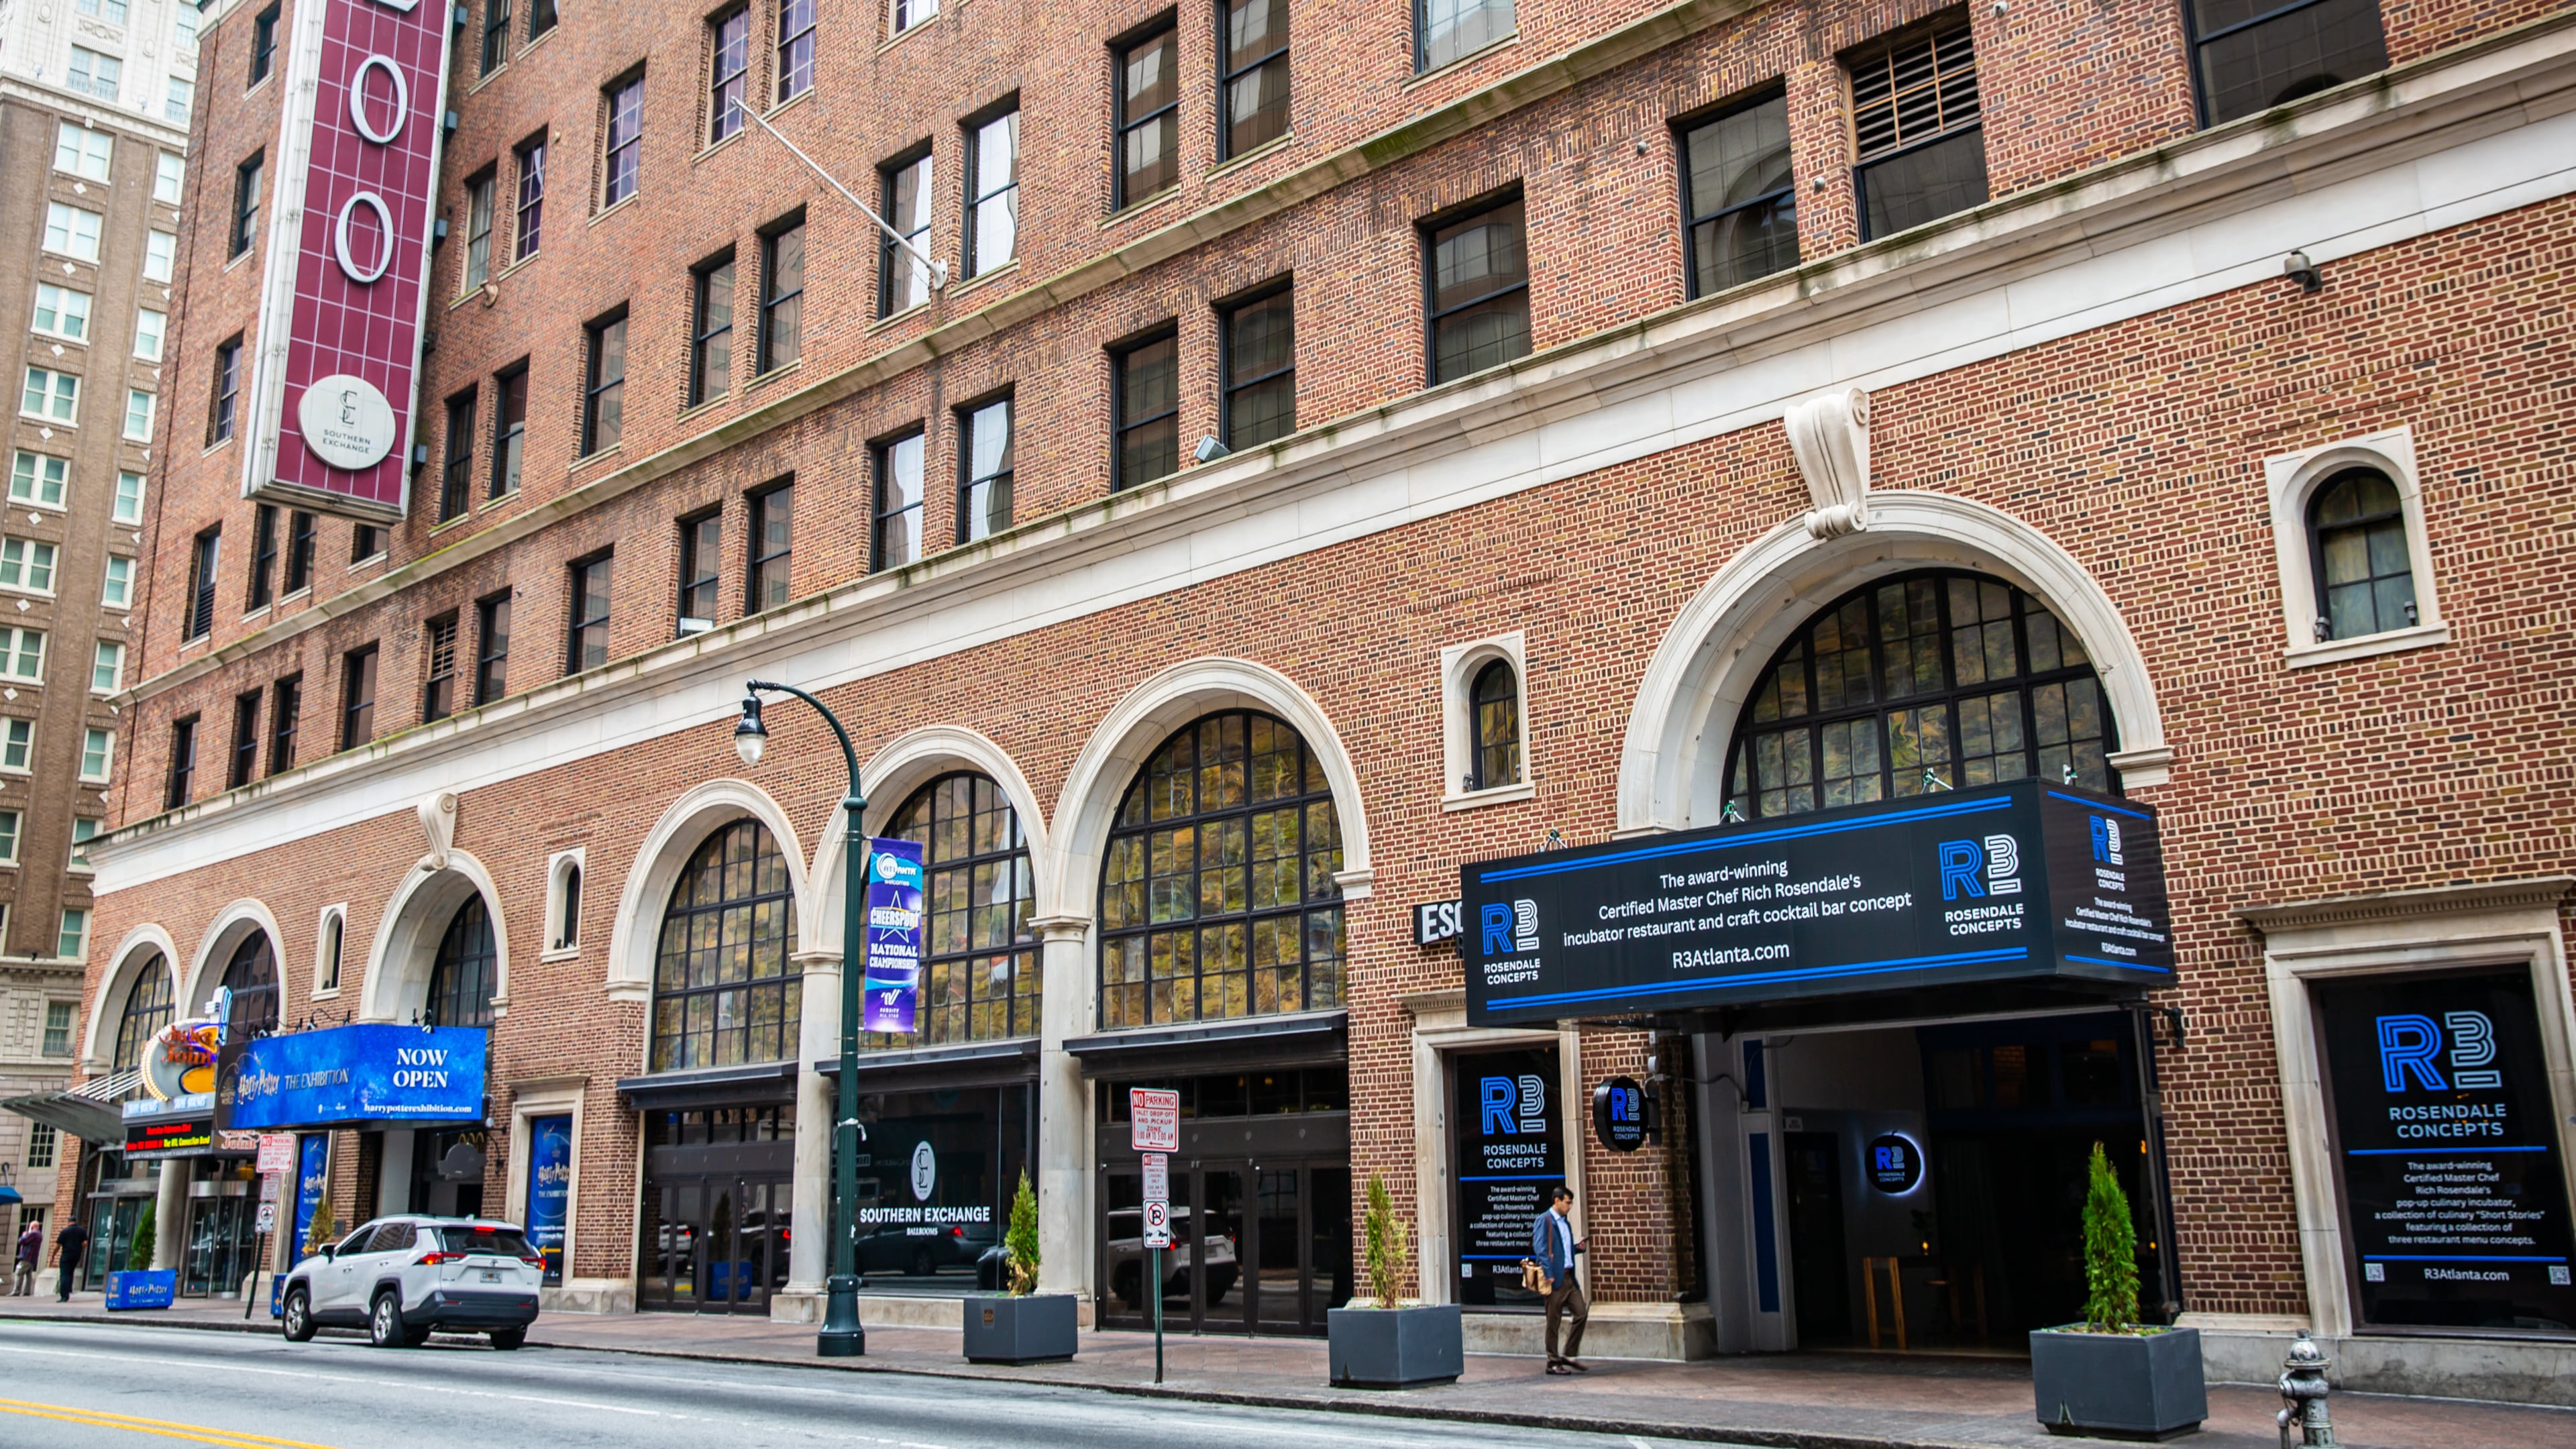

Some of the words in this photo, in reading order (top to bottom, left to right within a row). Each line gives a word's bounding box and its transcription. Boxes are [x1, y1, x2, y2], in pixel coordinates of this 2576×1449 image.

[335, 0, 420, 282] 00
[323, 429, 370, 445] SOUTHERN
[323, 438, 370, 454] EXCHANGE
[2089, 814, 2124, 865] R3
[1660, 873, 1685, 890] The
[1687, 860, 1788, 888] award-winning
[1938, 834, 2022, 900] R3
[2096, 867, 2125, 882] ROSENDALE
[2098, 878, 2125, 892] CONCEPTS
[1598, 899, 1654, 920] Certified
[1658, 894, 1703, 913] Master
[1706, 889, 1739, 907] Chef
[1742, 885, 1772, 902] Rich
[1775, 874, 1862, 898] Rosendale's
[870, 908, 920, 928] CHEERSPORT
[1563, 928, 1625, 947] incubator
[1627, 918, 1696, 938] restaurant
[1698, 913, 1724, 930] and
[1726, 908, 1761, 926] craft
[1763, 901, 1819, 924] cocktail
[1821, 898, 1846, 916] bar
[1849, 892, 1912, 914] concept
[1945, 903, 2024, 924] ROSENDALE
[1481, 898, 1540, 955] R3
[1949, 918, 2021, 936] CONCEPTS
[871, 943, 918, 957] NATIONAL
[1672, 943, 1790, 969] R3Atlanta.com
[869, 957, 918, 970] CHAMPIONSHIP
[1484, 958, 1540, 973] ROSENDALE
[1487, 970, 1539, 985] CONCEPTS
[161, 1046, 211, 1065] Joint
[396, 1048, 448, 1066] NOW
[2376, 1010, 2502, 1092] R3
[238, 1075, 258, 1105] Harry
[258, 1069, 280, 1096] Potter
[285, 1075, 300, 1090] THE
[301, 1068, 350, 1089] EXHIBITION
[393, 1070, 448, 1088] OPEN
[1133, 1093, 1144, 1107] NO
[1146, 1095, 1174, 1106] PARKING
[1481, 1075, 1546, 1135] R3
[1611, 1088, 1640, 1121] R3
[364, 1103, 472, 1114] harrypotterexhibition.com
[2389, 1104, 2507, 1120] ROSENDALE
[2397, 1122, 2504, 1138] CONCEPTS
[221, 1137, 256, 1149] Joint
[263, 1136, 272, 1146] NO
[1483, 1144, 1547, 1156] ROSENDALE
[1487, 1157, 1544, 1169] CONCEPTS
[2408, 1161, 2424, 1171] The
[2426, 1161, 2492, 1171] award-winning
[2404, 1173, 2443, 1182] Certified
[2445, 1173, 2475, 1182] Master
[2477, 1173, 2500, 1181] Chef
[2416, 1185, 2435, 1195] Rich
[2436, 1185, 2491, 1195] Rosendale's
[2396, 1199, 2428, 1208] pop-up
[2430, 1198, 2466, 1208] culinary
[2467, 1198, 2516, 1208] incubator,
[860, 1208, 921, 1223] SOUTHERN
[924, 1207, 990, 1222] EXCHANGE
[2381, 1210, 2425, 1220] collection
[2426, 1210, 2436, 1219] of
[2437, 1210, 2474, 1220] culinary
[906, 1227, 938, 1236] BALLROOMS
[2406, 1223, 2447, 1233] featuring
[2455, 1223, 2501, 1232] collection
[2502, 1223, 2512, 1231] of
[2388, 1236, 2412, 1244] three
[2414, 1236, 2461, 1244] restaurant
[2490, 1236, 2536, 1245] concepts.
[2424, 1269, 2510, 1281] R3Atlanta.com
